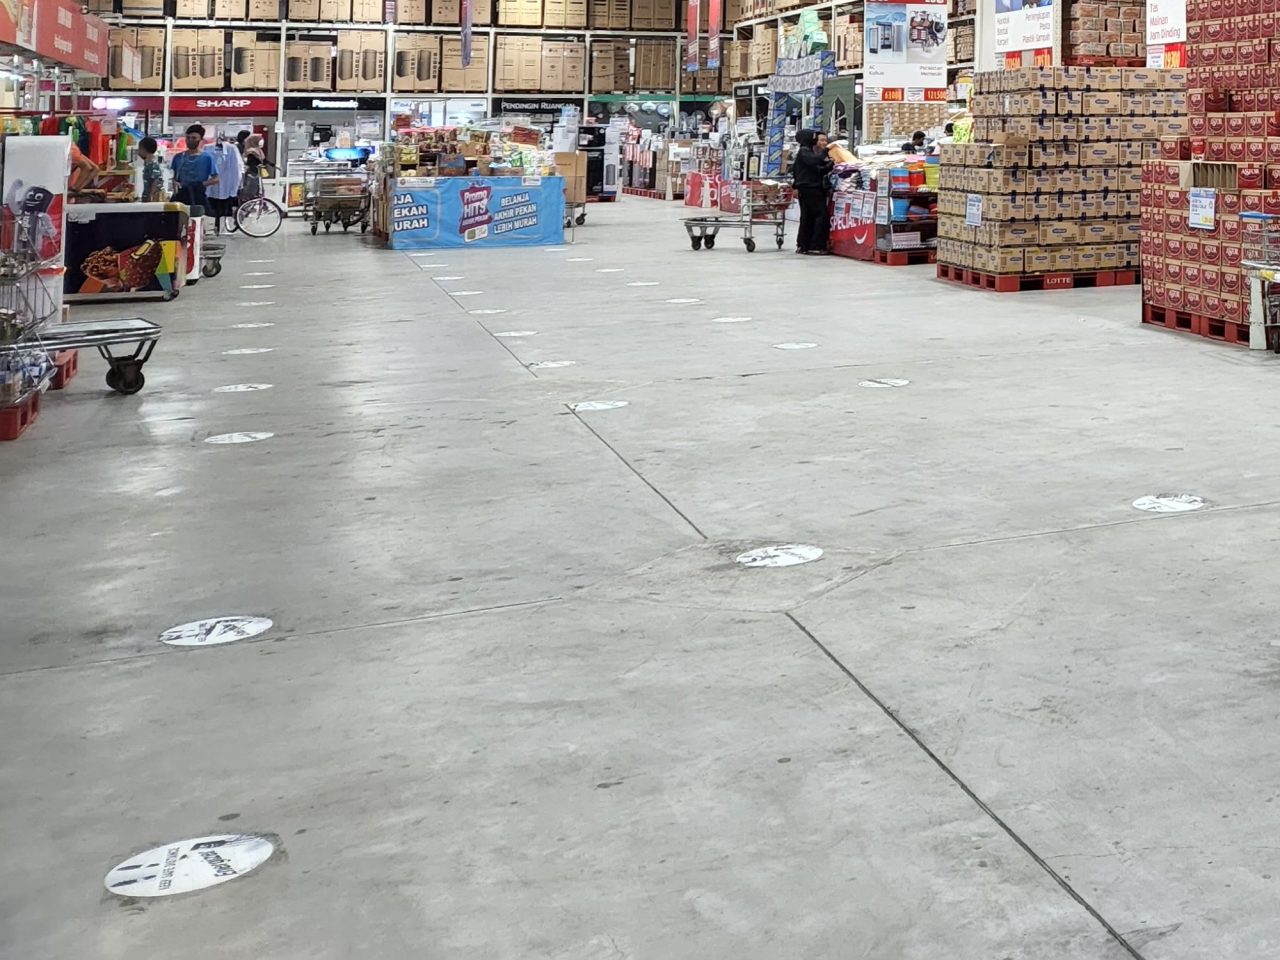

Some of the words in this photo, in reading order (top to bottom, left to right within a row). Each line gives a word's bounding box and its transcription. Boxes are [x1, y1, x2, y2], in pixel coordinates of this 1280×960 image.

[196, 100, 251, 108] SHARP
[501, 102, 539, 111] PENDINGIN
[464, 190, 487, 203] Promo
[501, 192, 529, 207] BELANJA
[495, 208, 514, 220] AKHIR
[516, 204, 537, 216] PEKAN
[494, 221, 513, 234] LEBIH
[514, 216, 537, 229] MURAH
